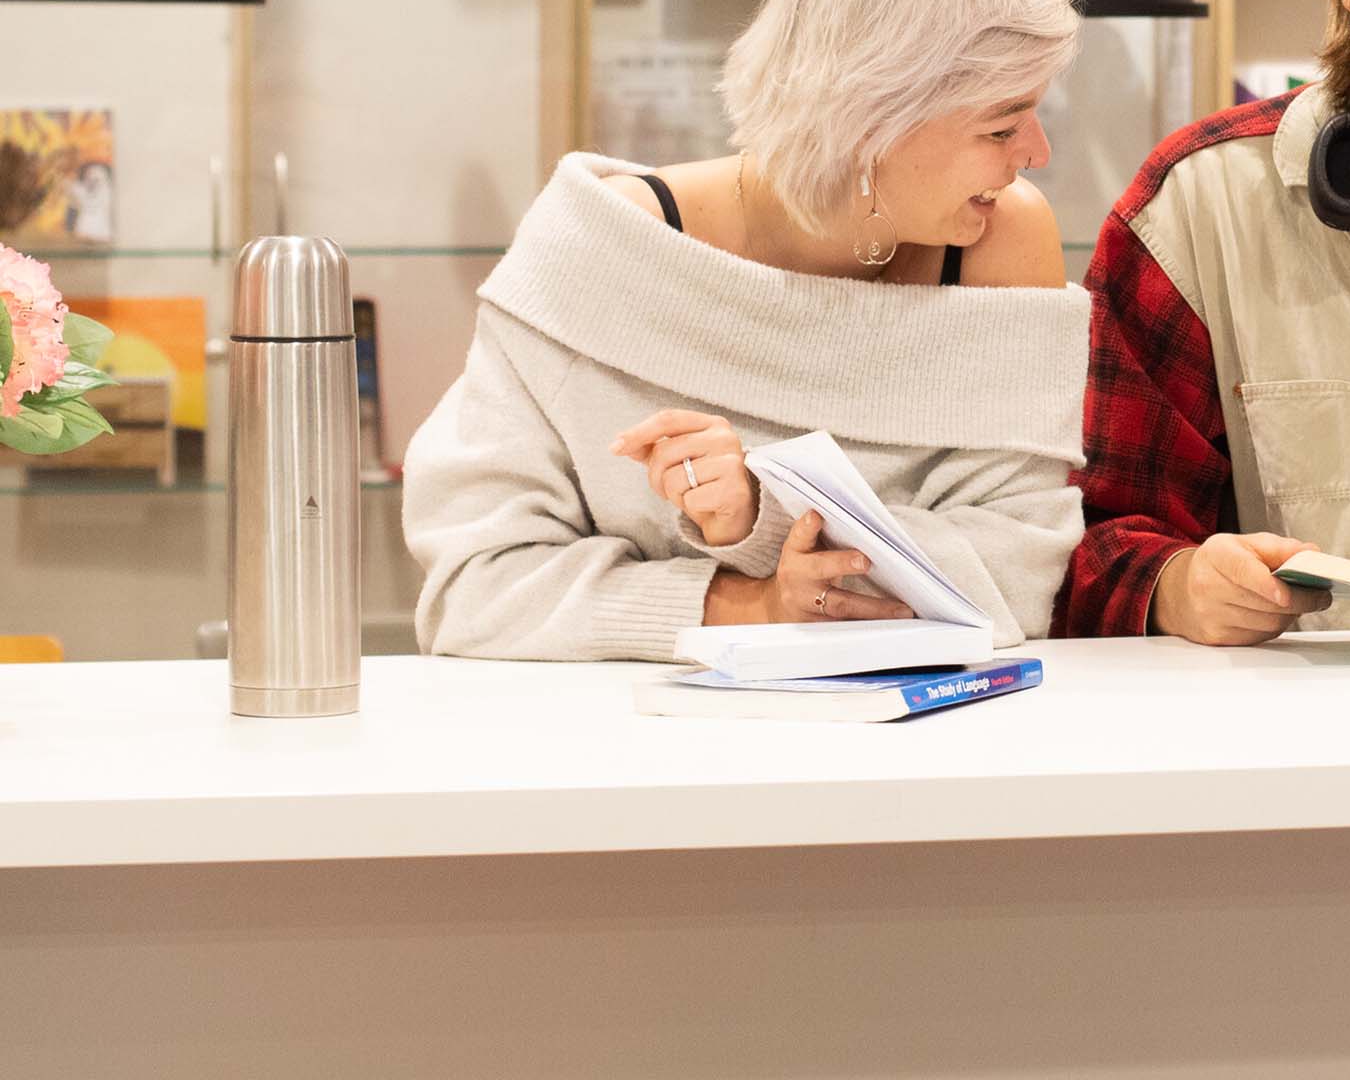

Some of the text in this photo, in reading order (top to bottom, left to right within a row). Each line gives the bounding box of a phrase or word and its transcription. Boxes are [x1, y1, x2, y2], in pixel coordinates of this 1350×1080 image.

[926, 687, 939, 699] The
[939, 683, 956, 698] Study
[963, 676, 990, 693] Language
